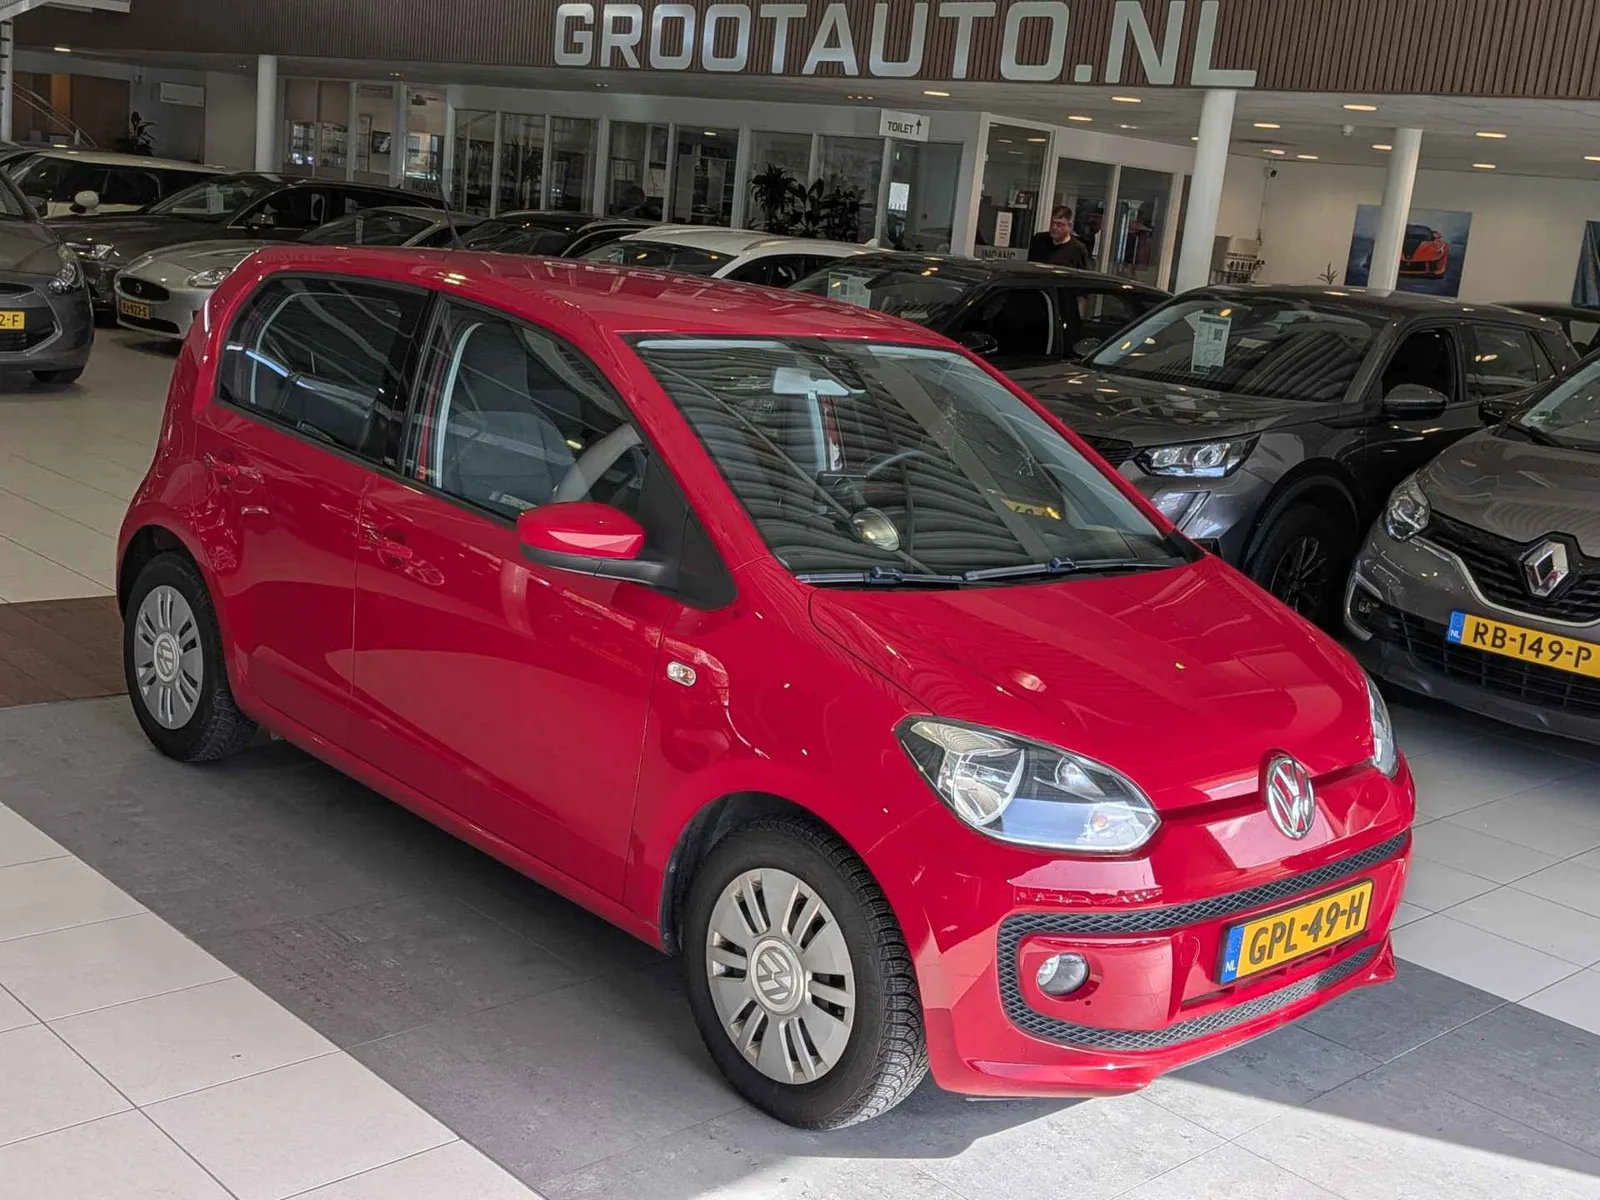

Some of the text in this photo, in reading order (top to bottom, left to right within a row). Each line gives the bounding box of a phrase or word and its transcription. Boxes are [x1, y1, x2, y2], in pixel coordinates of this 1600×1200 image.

[554, 0, 1258, 87] GROOTAUTO.NL
[887, 121, 914, 134] TOILET
[1450, 629, 1461, 639] NL
[1472, 621, 1592, 668] RB-149-P
[1249, 891, 1364, 965] GPL-49-H
[1224, 961, 1236, 973] NL
